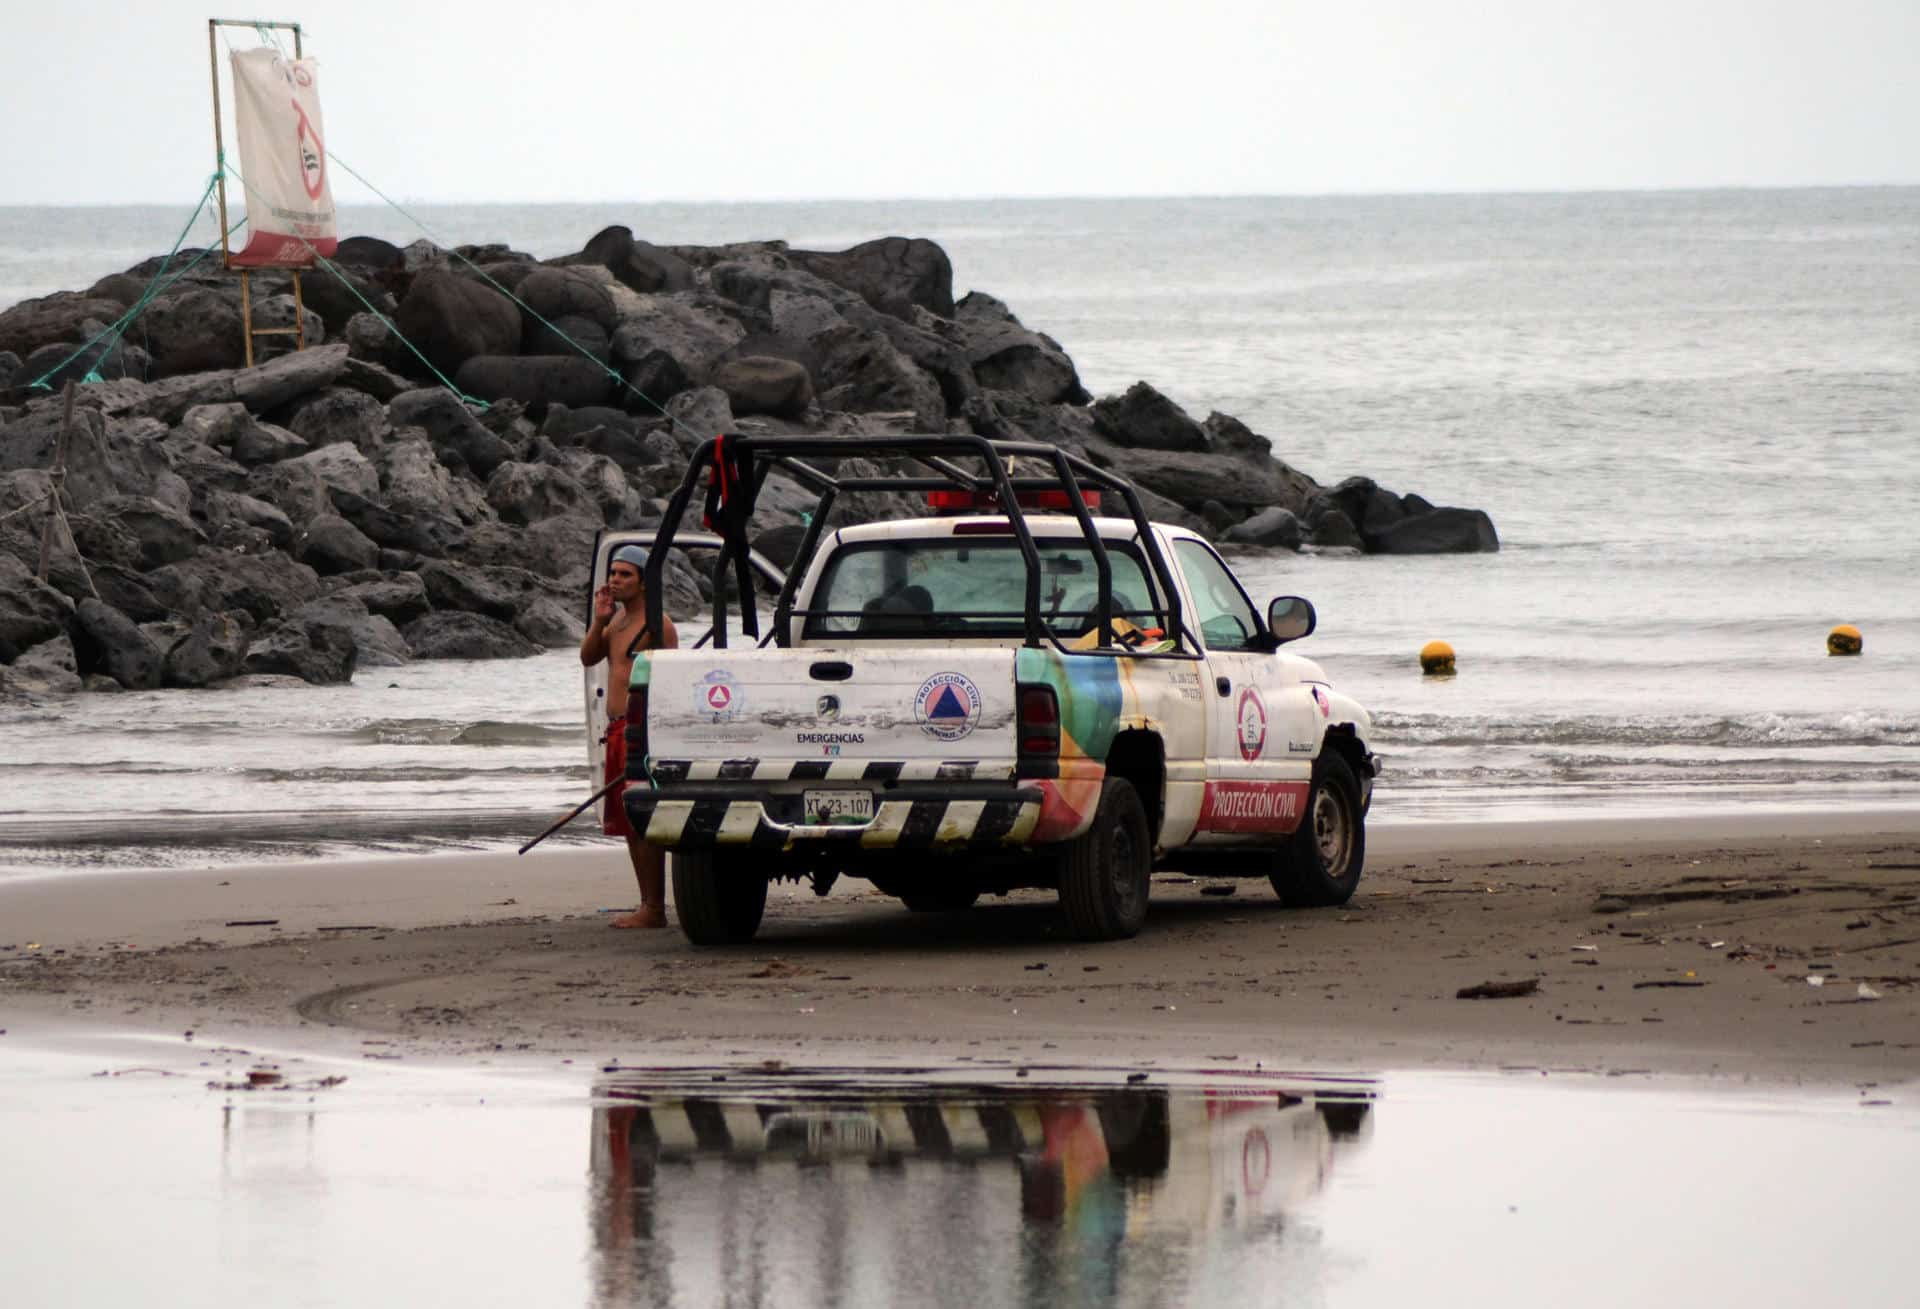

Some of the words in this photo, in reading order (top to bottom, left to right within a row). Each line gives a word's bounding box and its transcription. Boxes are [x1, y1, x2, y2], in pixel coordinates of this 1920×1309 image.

[918, 675, 966, 704] PROTECCIÓN
[966, 685, 979, 709] CIVIL
[797, 733, 864, 743] EMERGENCIAS
[1210, 787, 1274, 817] PROTECCIÓN
[1274, 791, 1297, 817] CIVIL
